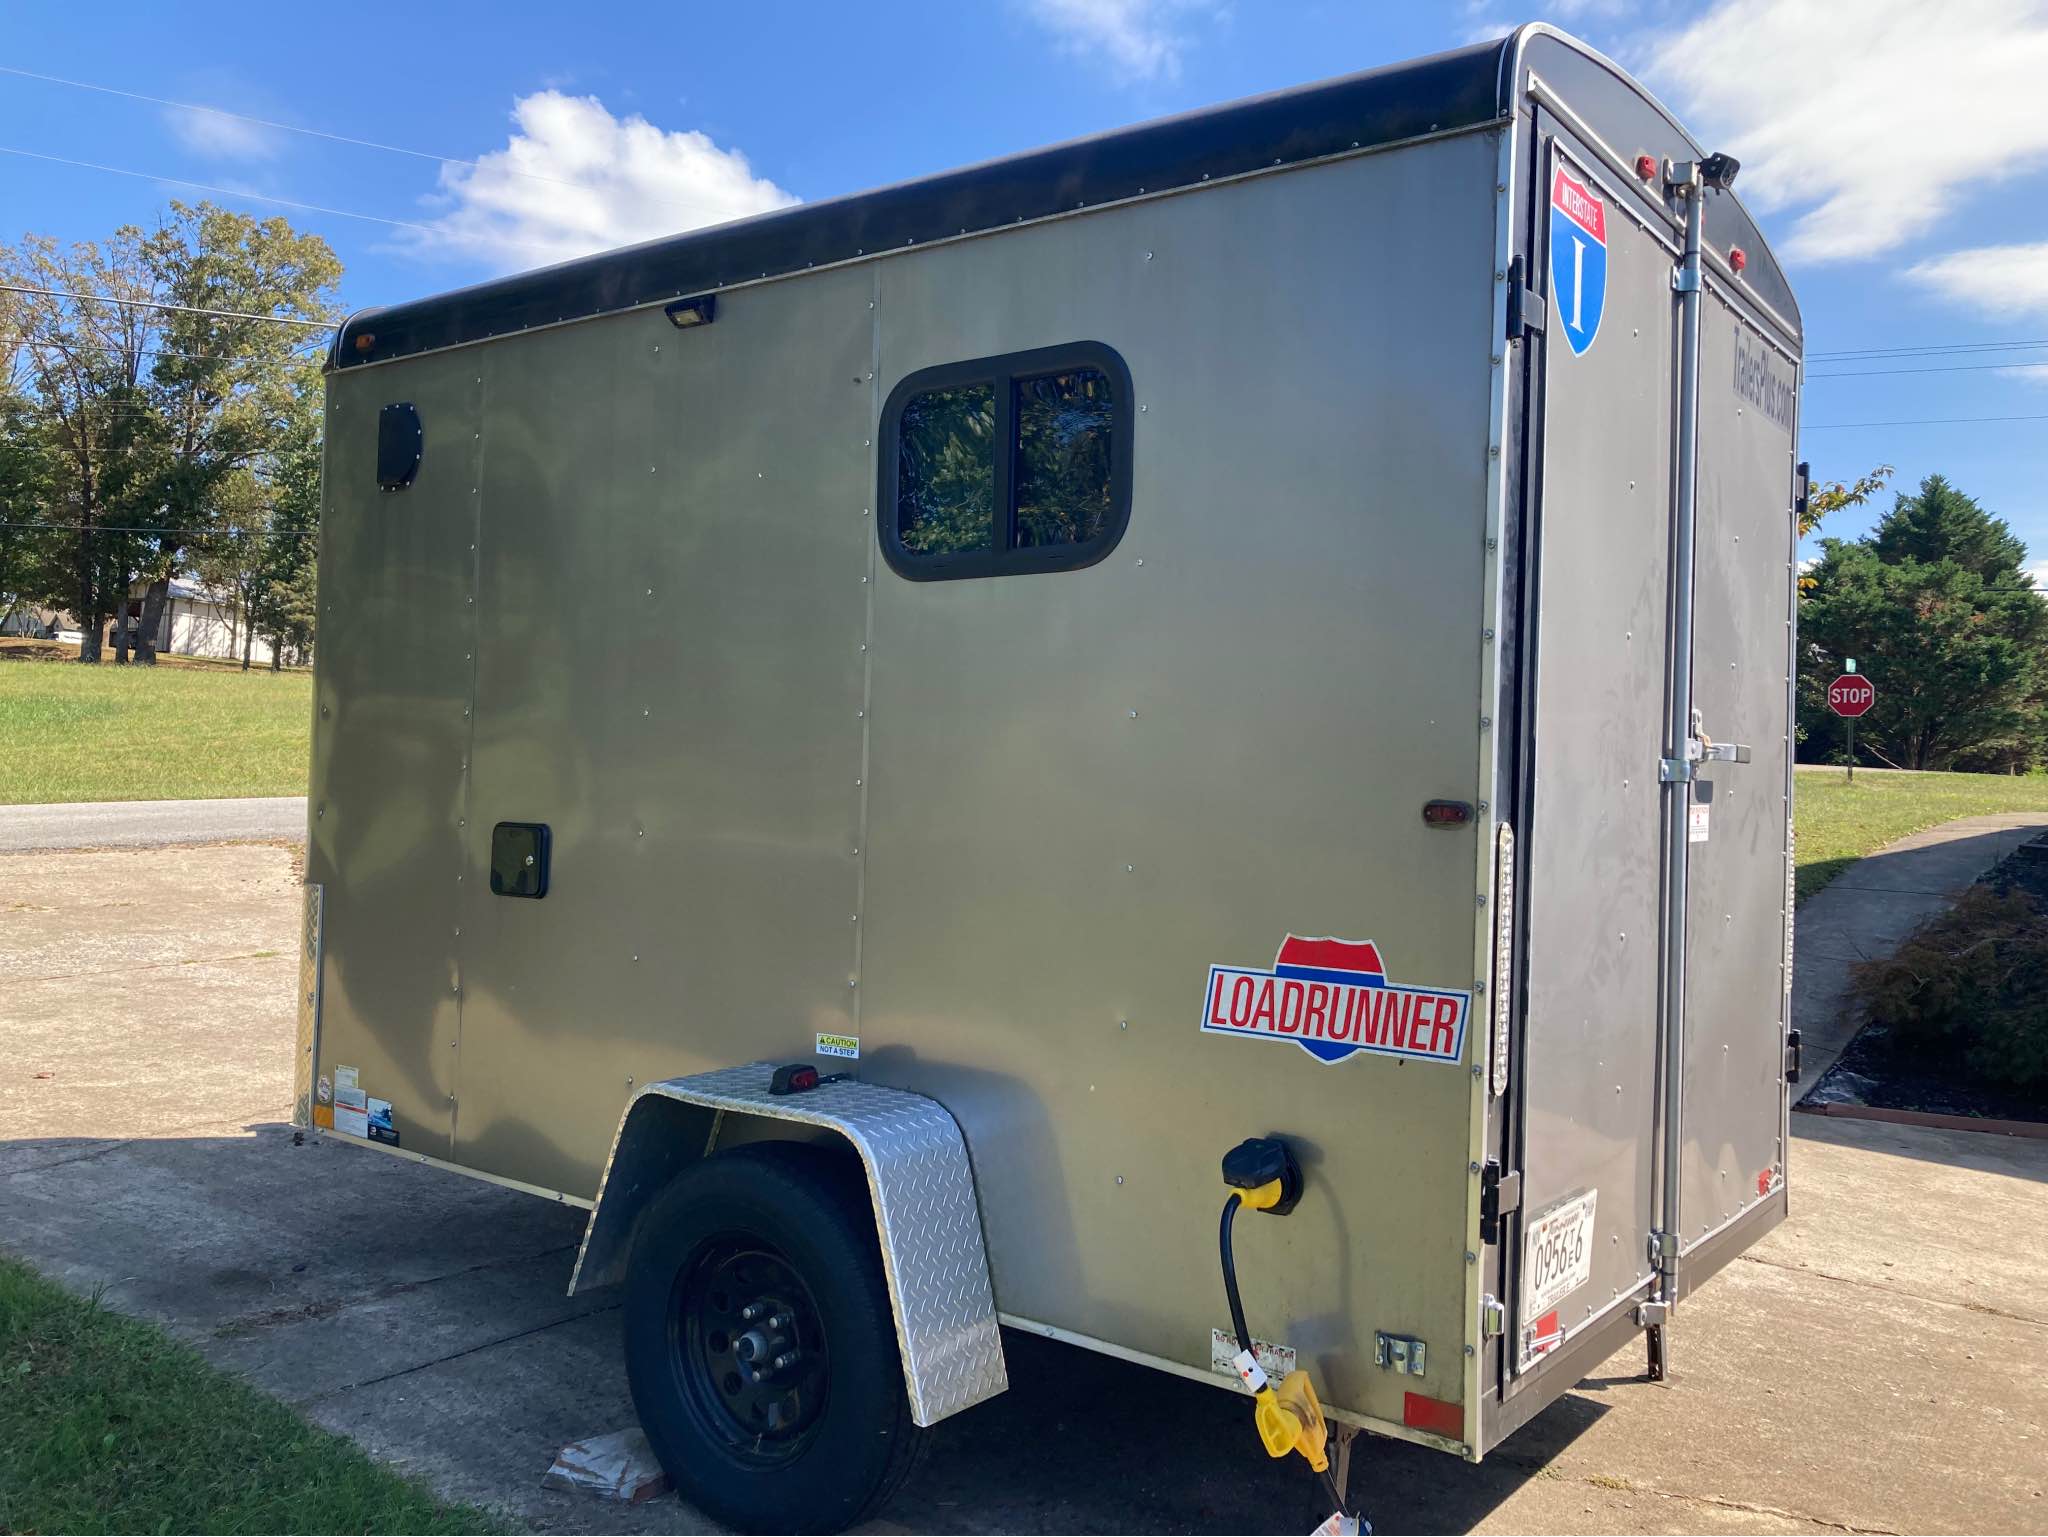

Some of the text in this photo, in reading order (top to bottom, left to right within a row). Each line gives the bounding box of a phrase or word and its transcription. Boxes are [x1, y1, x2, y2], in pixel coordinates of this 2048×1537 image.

[1562, 181, 1598, 231] INTERSTATE
[1733, 325, 1791, 434] TrailersPlus.com
[1831, 688, 1871, 704] STOP
[1210, 973, 1459, 1054] LOADRUNNER
[820, 1045, 832, 1053] NOT
[839, 1048, 855, 1056] STEP
[826, 1037, 857, 1048] CAUTION
